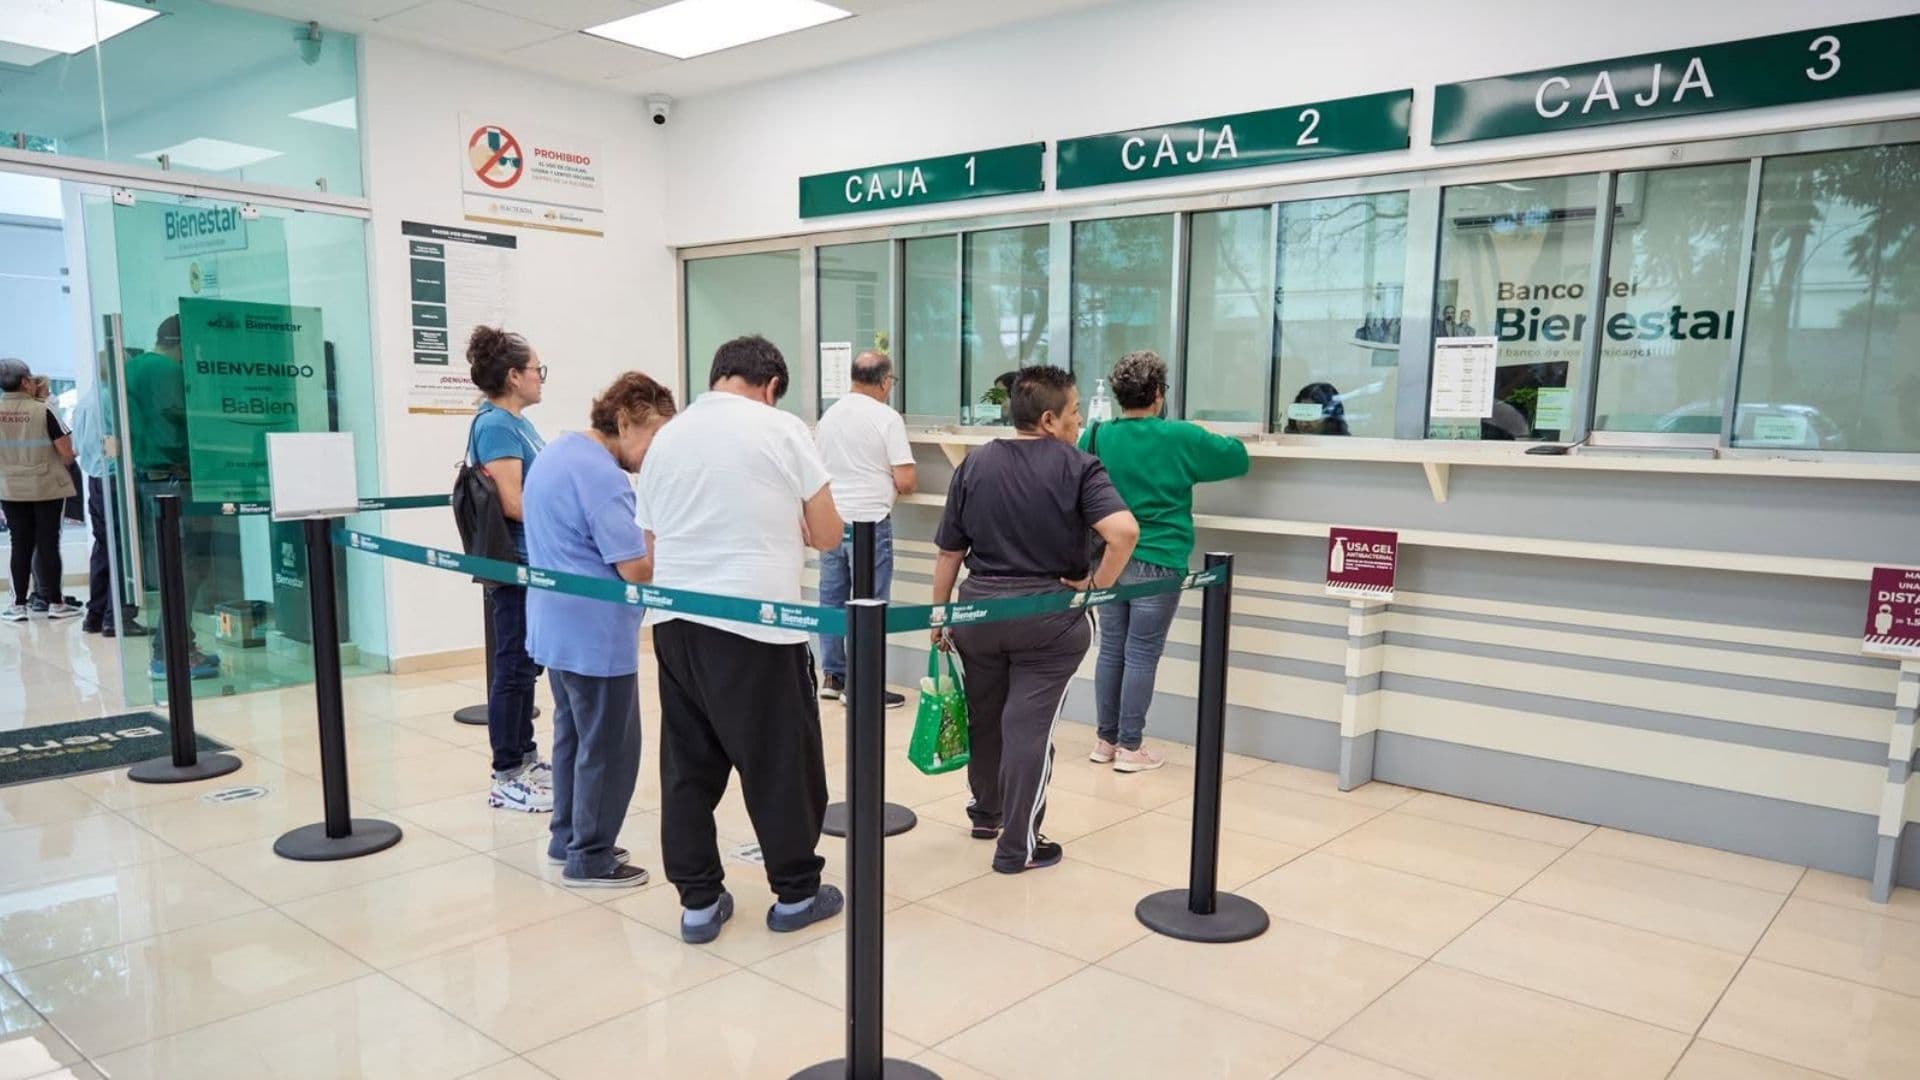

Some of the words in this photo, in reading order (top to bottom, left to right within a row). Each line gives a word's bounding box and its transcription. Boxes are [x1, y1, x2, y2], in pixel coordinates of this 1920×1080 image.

[1535, 57, 1714, 118] CAJA
[1806, 35, 1841, 81] 3
[1121, 124, 1239, 171] CAJA
[1296, 108, 1320, 146] 2
[534, 148, 591, 166] PROHIBIDO
[845, 166, 928, 203] CAJA
[964, 156, 976, 186] 1
[165, 205, 238, 240] Bienestar
[1497, 281, 1585, 300] Banco
[245, 320, 303, 332] Bienestar
[196, 361, 314, 378] BIENVENIDO
[221, 397, 296, 415] BaBien
[1346, 542, 1370, 552] USA
[1372, 544, 1394, 554] GEL
[781, 613, 819, 626] Bienestar
[951, 609, 988, 621] Bienestar
